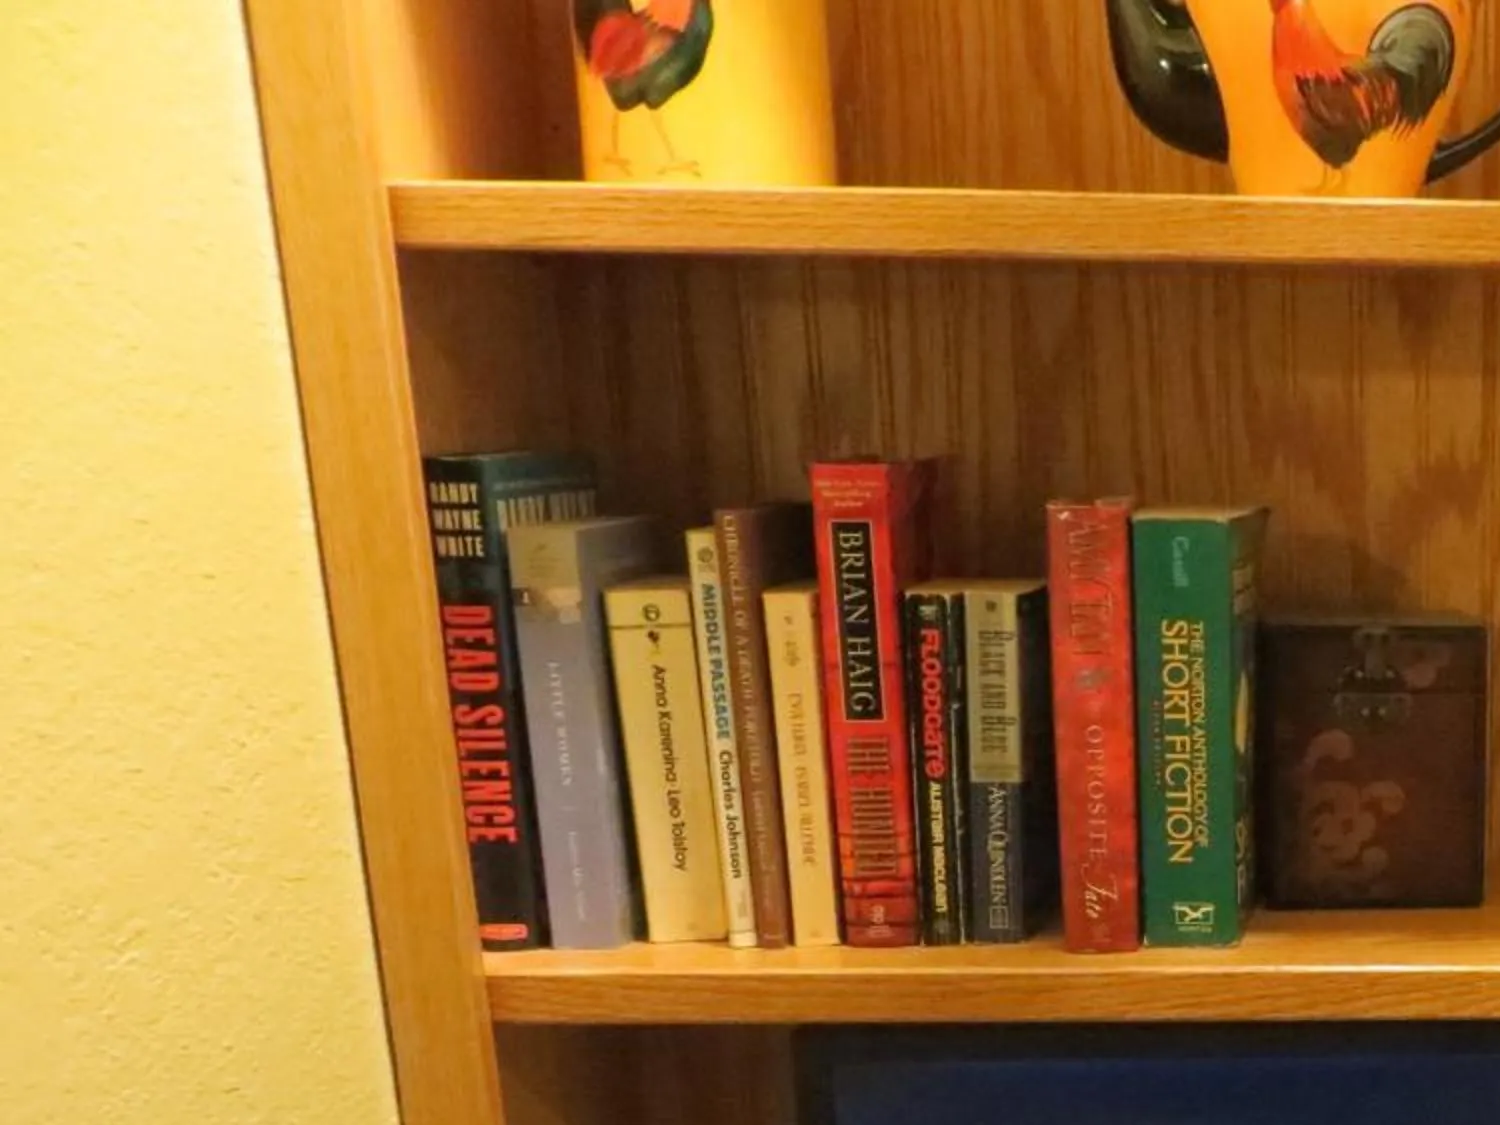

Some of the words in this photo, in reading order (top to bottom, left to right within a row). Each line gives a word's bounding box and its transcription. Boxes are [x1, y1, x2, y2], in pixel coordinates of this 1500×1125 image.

[436, 535, 485, 557] WHITE
[837, 531, 868, 624] BRIAN
[441, 604, 501, 692] DEAD
[701, 583, 722, 656] MIDDLE
[978, 629, 1016, 676] BLACK
[1189, 621, 1206, 654] THE
[650, 664, 670, 707] Anna
[709, 659, 731, 740] PASSAGE
[847, 636, 874, 712] HAIG
[981, 683, 1008, 710] AND
[1160, 618, 1191, 730] SHORT
[1189, 656, 1207, 723] NORTON
[980, 715, 1018, 755] BLUE
[454, 703, 519, 846] SILENCE
[667, 788, 684, 818] Leo
[718, 749, 738, 810] Charles
[1085, 724, 1110, 860] OPPOSITE
[1163, 734, 1196, 864] FICTION
[1191, 725, 1208, 822] ANTHOLOGY
[987, 786, 1007, 831] ANNA
[1192, 824, 1209, 848] OF
[671, 821, 689, 871] Tolstoy
[723, 813, 745, 880] Johnson
